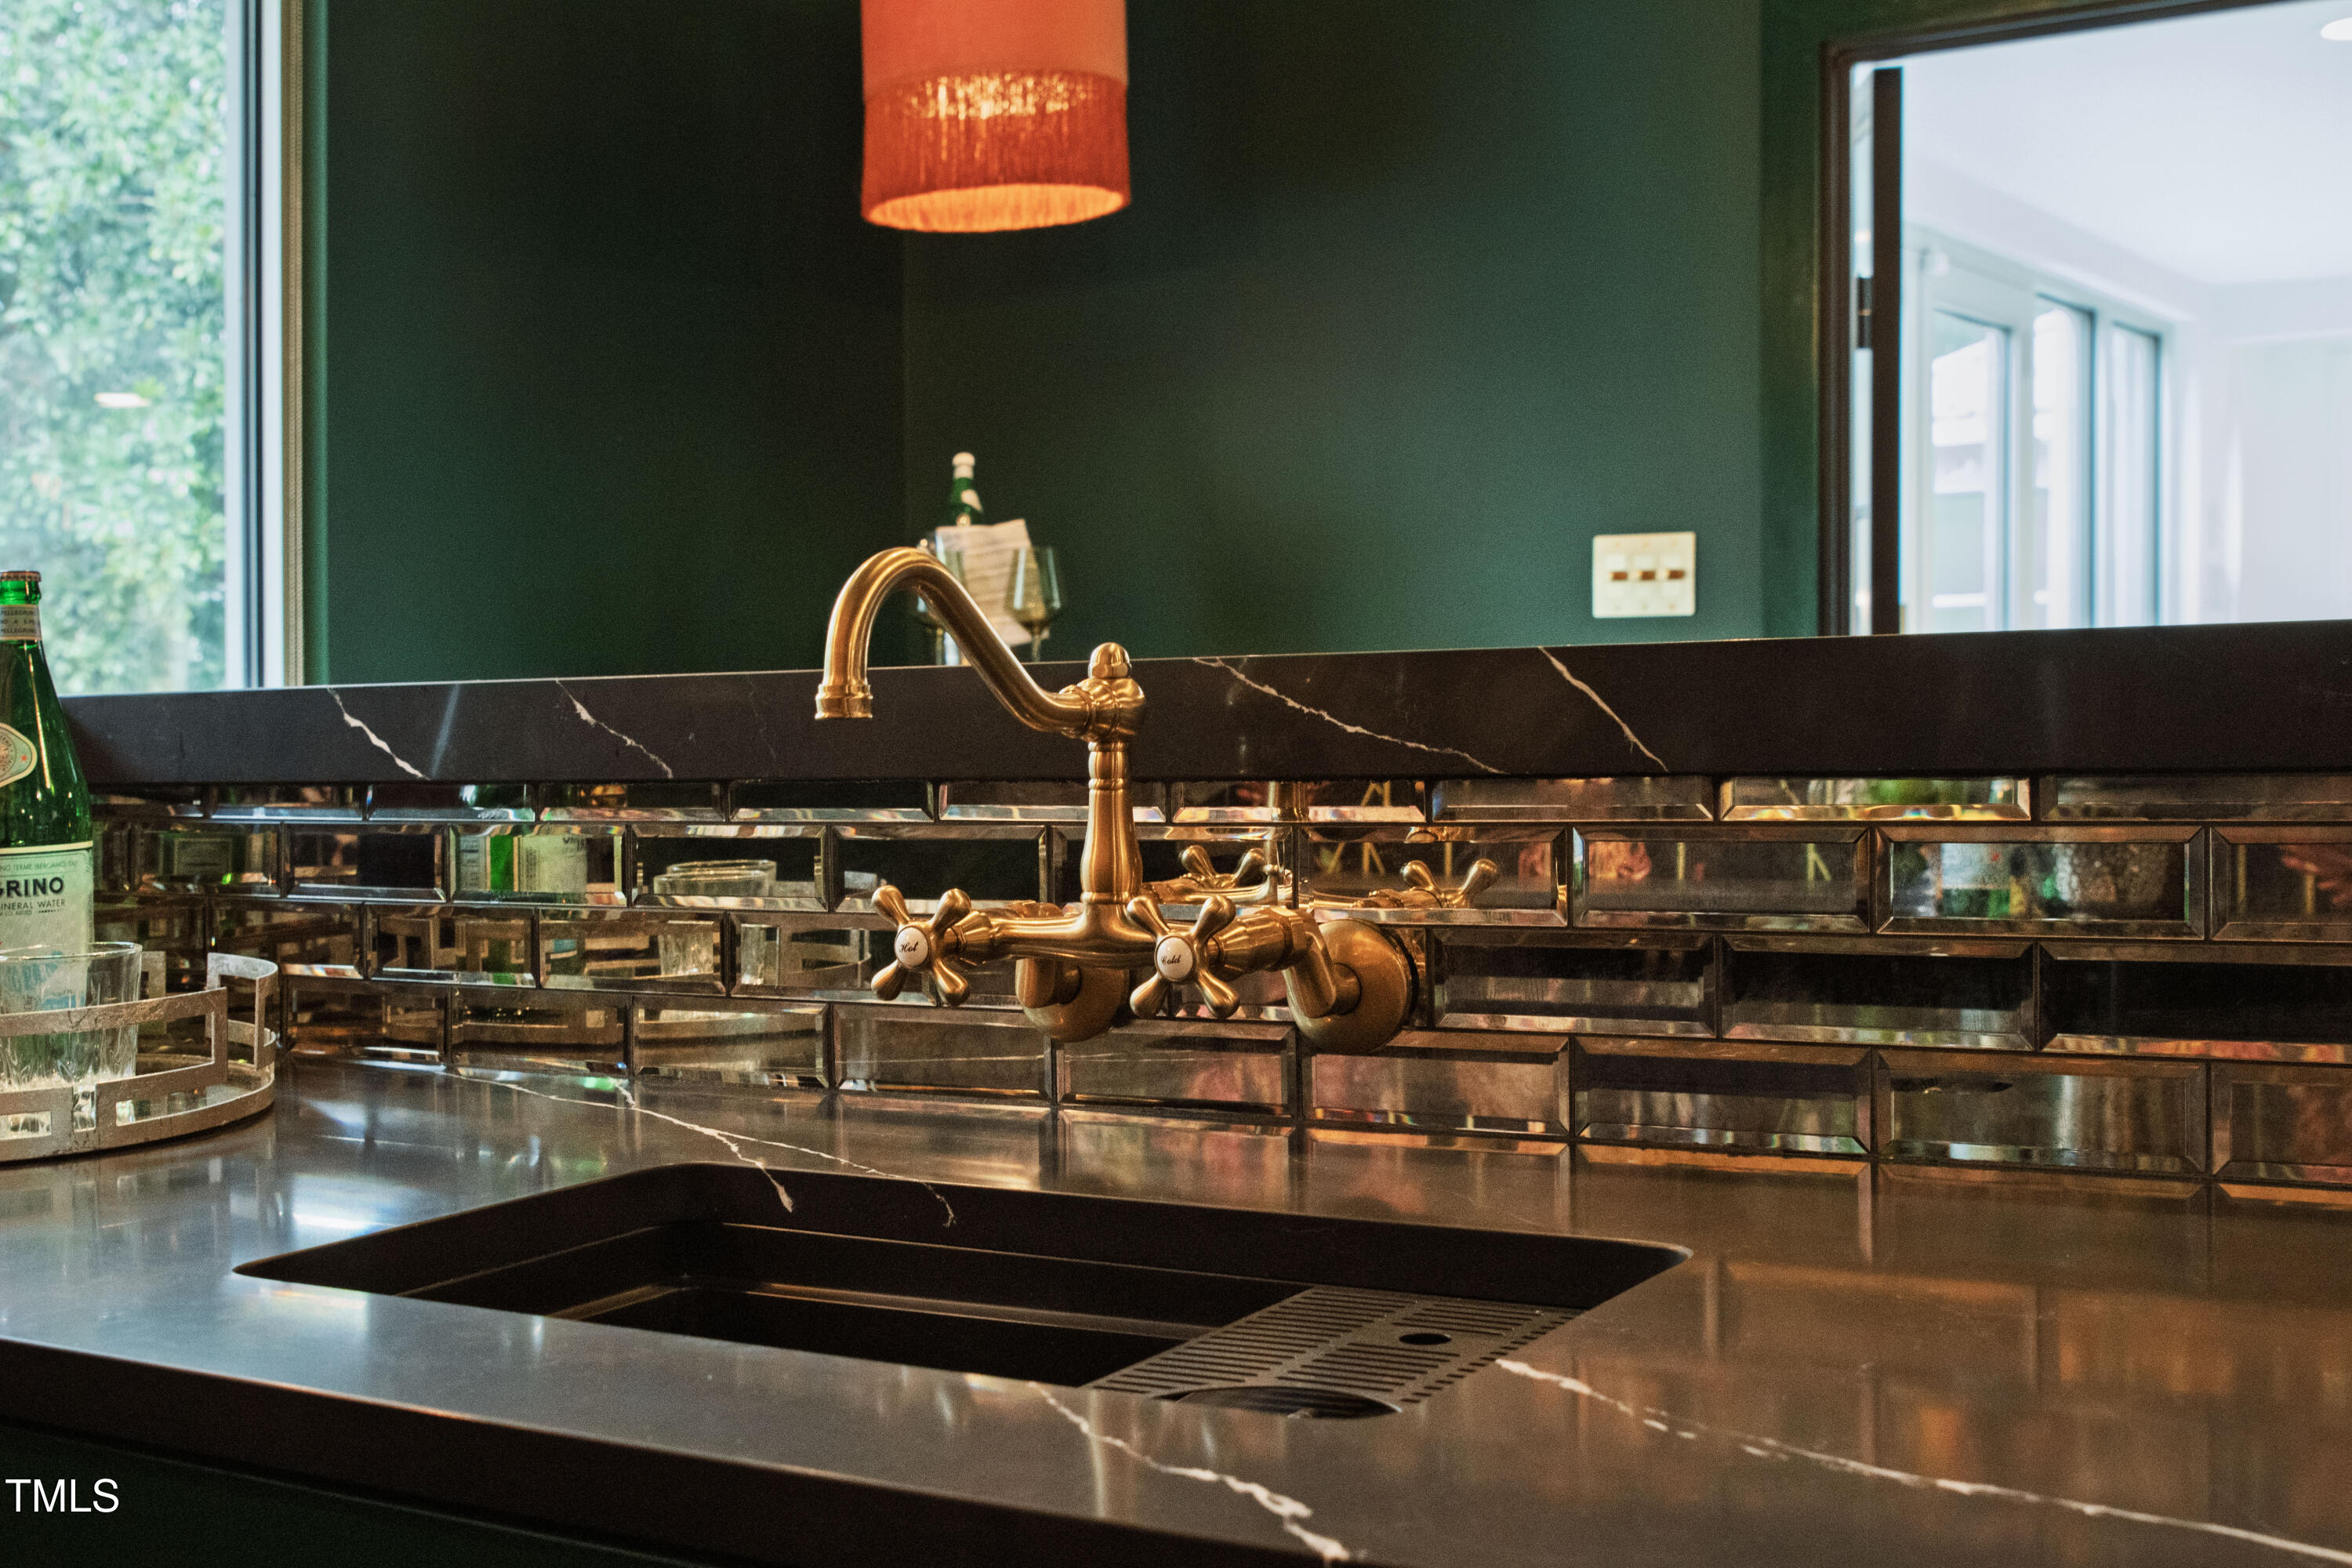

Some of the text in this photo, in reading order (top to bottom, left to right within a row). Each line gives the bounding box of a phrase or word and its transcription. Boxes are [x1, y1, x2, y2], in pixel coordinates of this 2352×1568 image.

[0, 877, 64, 898] RINO
[38, 899, 65, 908] WATER
[899, 941, 918, 953] Hot
[1160, 954, 1181, 965] Cold
